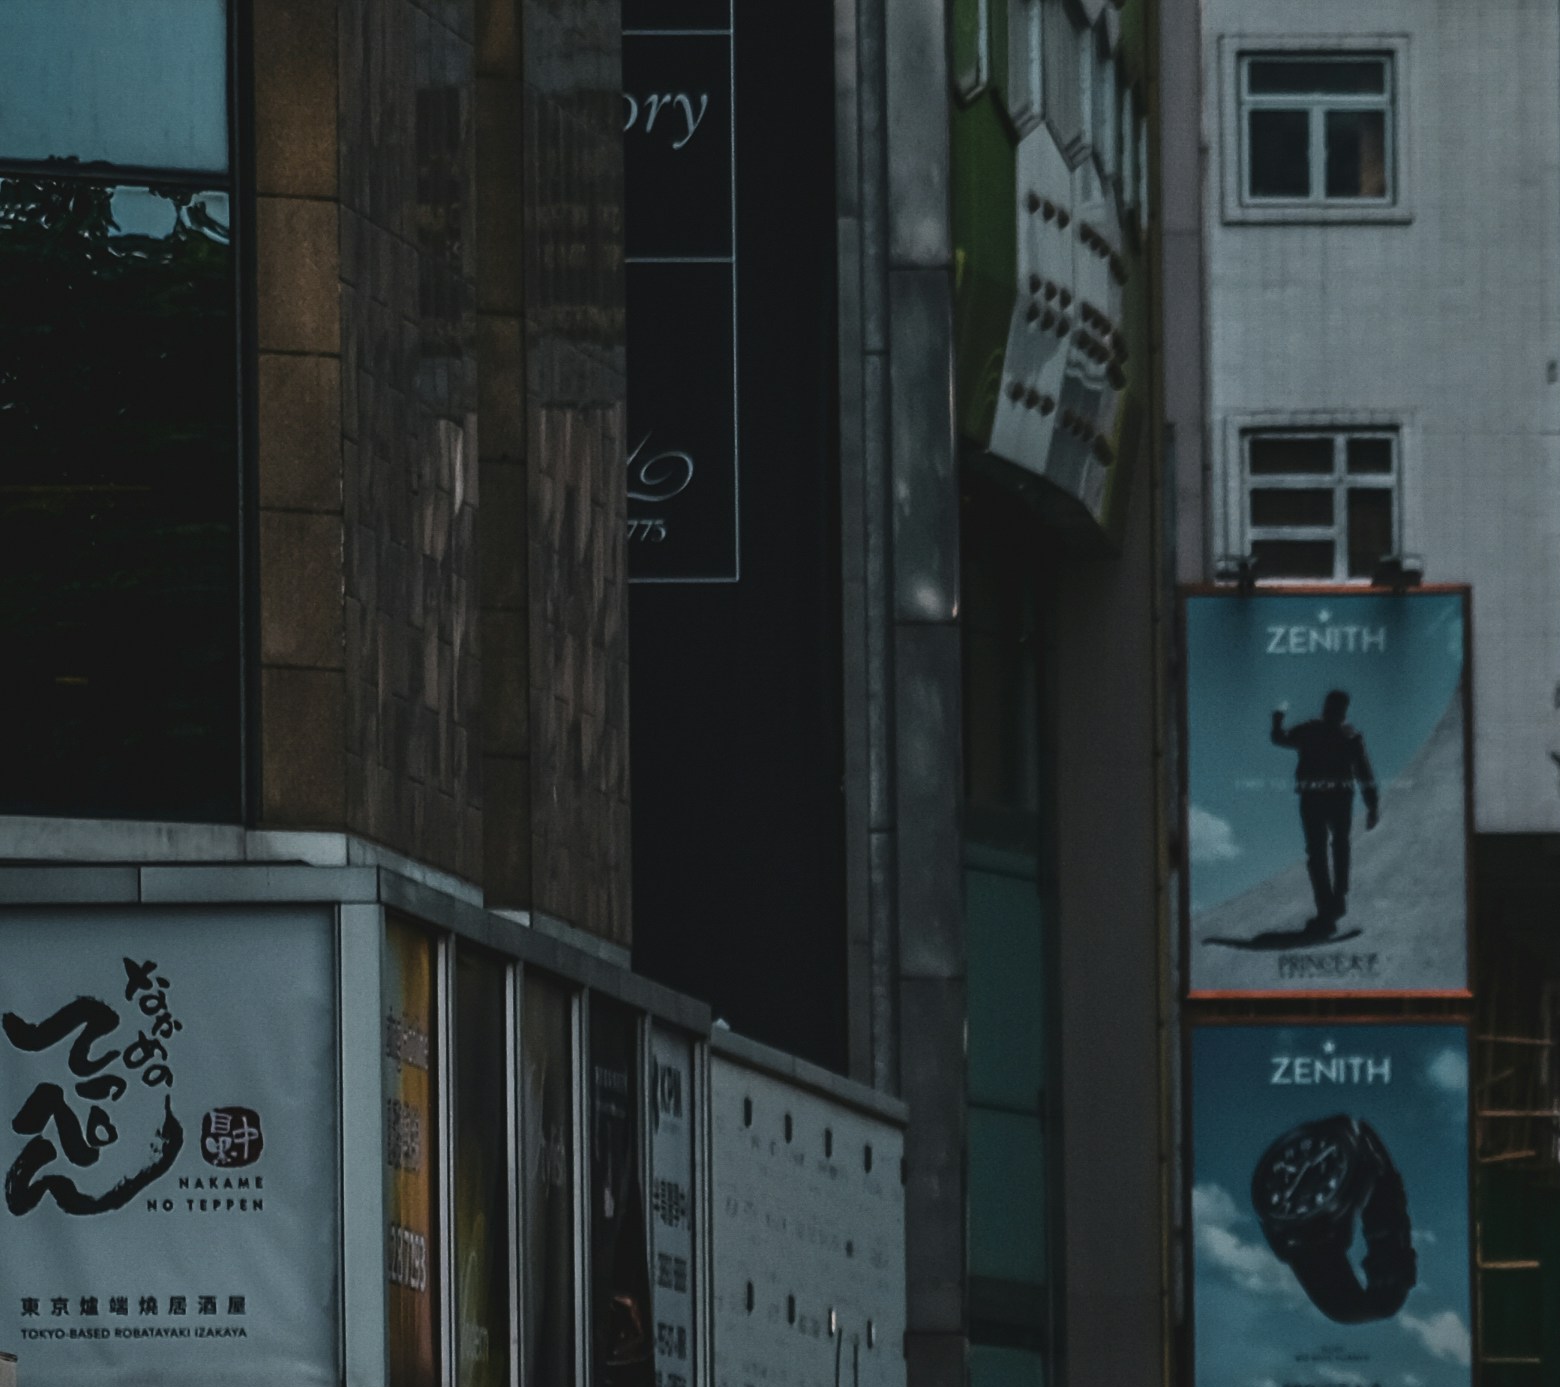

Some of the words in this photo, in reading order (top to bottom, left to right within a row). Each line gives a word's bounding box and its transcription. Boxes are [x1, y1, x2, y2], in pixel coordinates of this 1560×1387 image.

[1265, 624, 1387, 654] ZENITH
[1270, 1056, 1392, 1086] ZENITH
[179, 1177, 264, 1190] NAKAME
[147, 1199, 174, 1212] NO
[188, 1199, 264, 1212] TEPPEN
[21, 1295, 246, 1317] 東京爐端燒居酒屋
[114, 1327, 190, 1339] ROBATAYAKI
[195, 1327, 247, 1338] IZAKAYA
